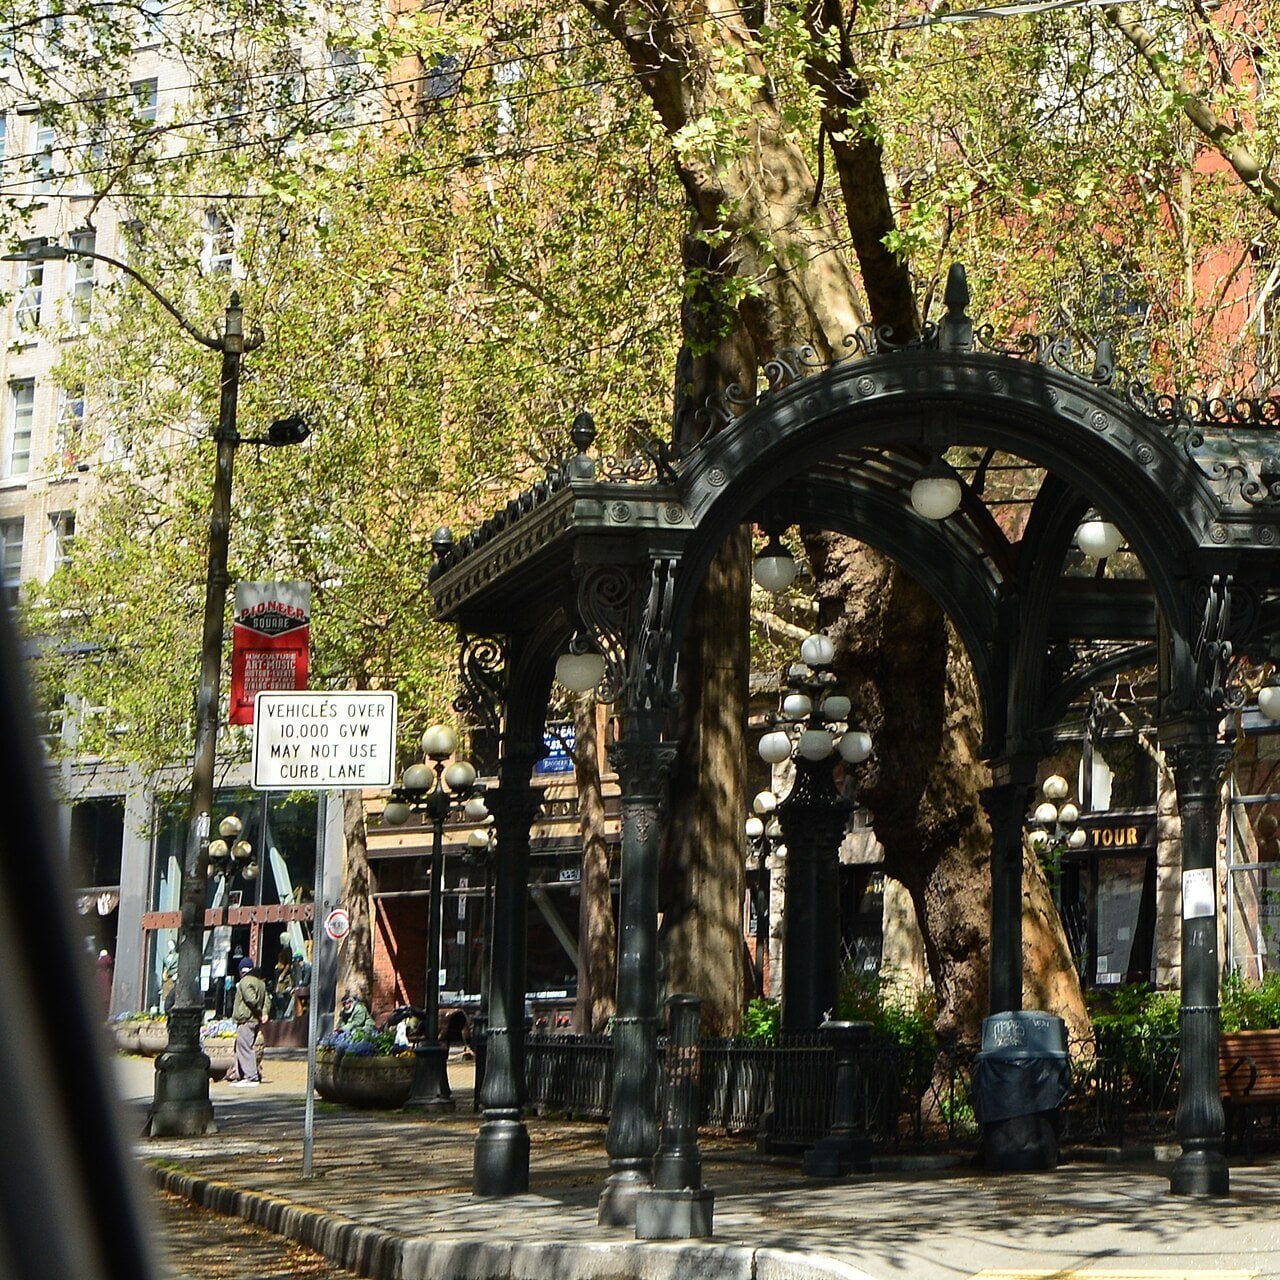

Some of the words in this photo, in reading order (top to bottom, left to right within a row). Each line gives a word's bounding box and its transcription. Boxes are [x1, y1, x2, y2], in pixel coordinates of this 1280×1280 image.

[240, 600, 306, 621] PIONEER
[253, 617, 289, 628] SQUARE
[267, 703, 337, 718] VEHICLES
[347, 703, 385, 718] OVER
[280, 723, 329, 739] 10,000
[339, 723, 370, 738] GVW
[270, 744, 300, 758] MAY
[311, 744, 339, 758] NOT
[349, 743, 377, 758] USE
[280, 764, 319, 778] CURB
[328, 764, 366, 778] LANE
[1091, 826, 1138, 847] TOUR
